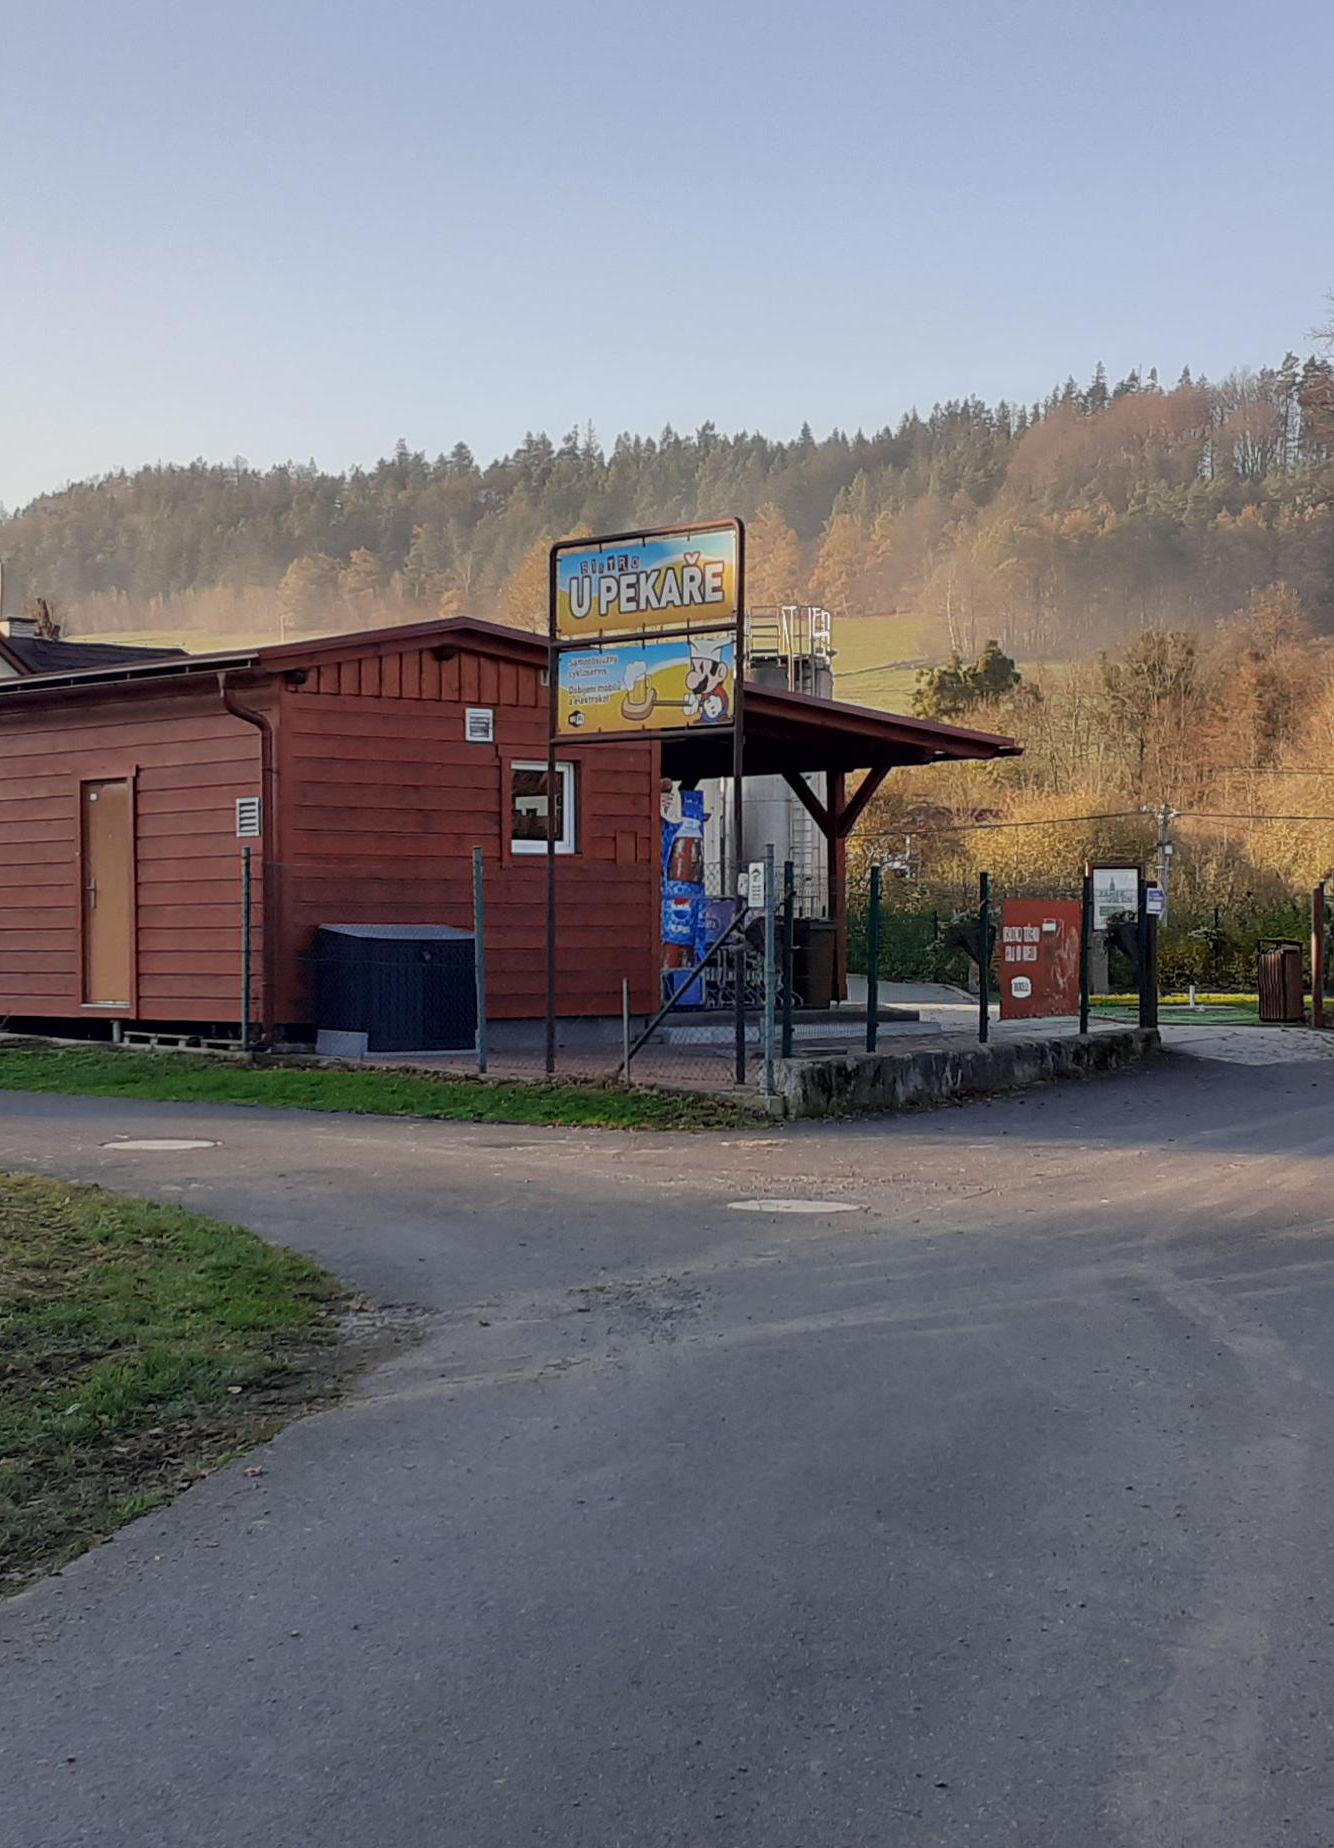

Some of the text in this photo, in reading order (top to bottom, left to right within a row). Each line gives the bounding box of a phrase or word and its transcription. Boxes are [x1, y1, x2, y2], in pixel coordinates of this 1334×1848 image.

[570, 551, 725, 619] U PEKAŘE
[580, 554, 640, 575] BISTRO
